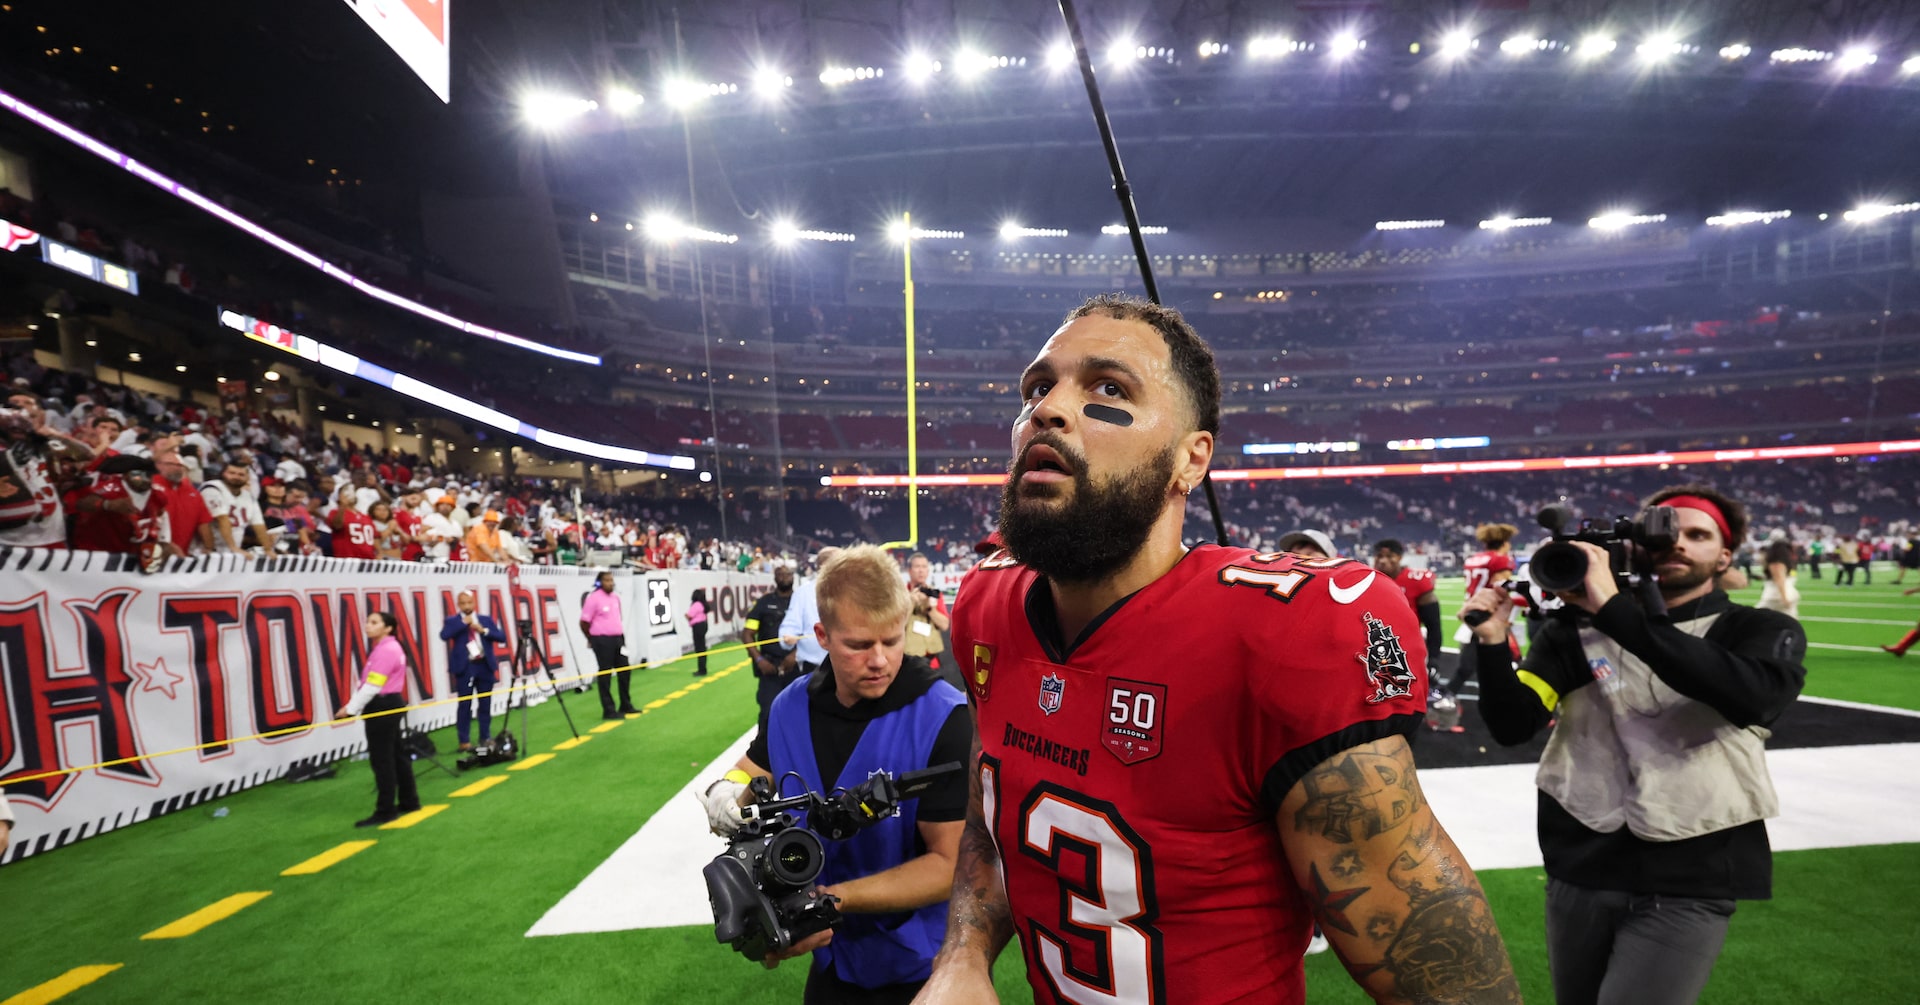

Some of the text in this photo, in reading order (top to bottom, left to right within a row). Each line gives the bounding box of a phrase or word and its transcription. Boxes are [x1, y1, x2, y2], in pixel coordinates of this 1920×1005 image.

[349, 523, 374, 546] 50
[161, 589, 436, 759] TOWN
[974, 644, 991, 685] C
[1042, 690, 1058, 708] NFL
[1109, 688, 1156, 730] 50
[1002, 721, 1090, 777] BUCCANEERS
[1113, 728, 1146, 740] SEASONS
